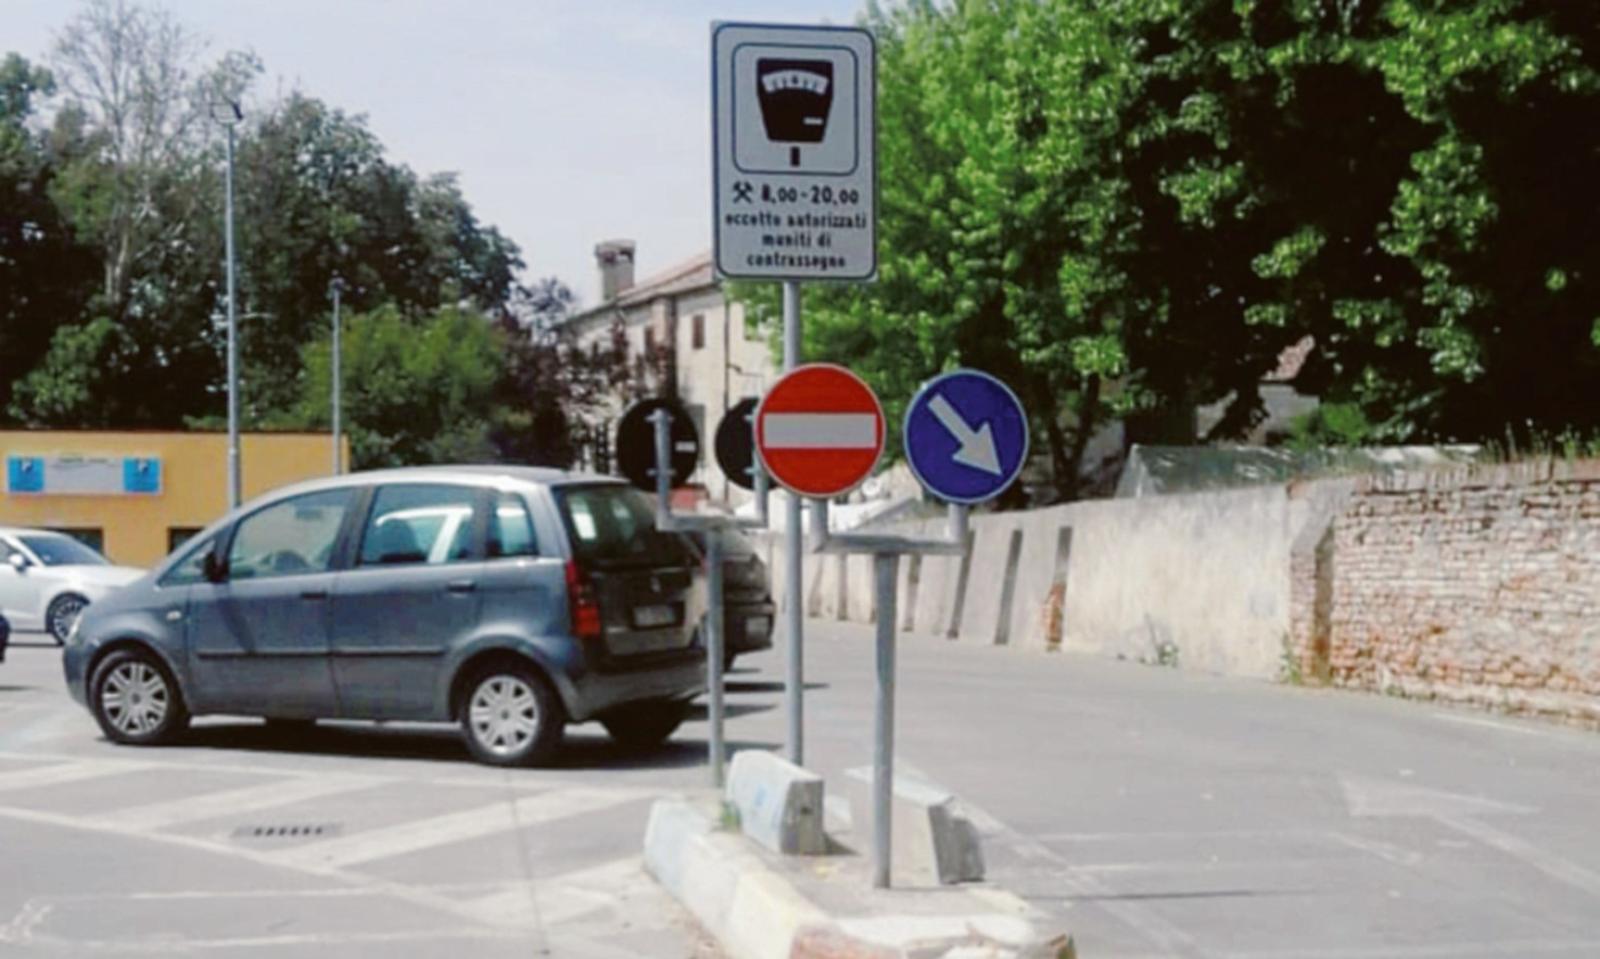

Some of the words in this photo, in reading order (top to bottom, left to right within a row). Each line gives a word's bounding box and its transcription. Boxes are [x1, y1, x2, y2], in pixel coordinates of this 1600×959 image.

[725, 212, 781, 226] eccetto
[787, 212, 868, 228] autorizzati
[762, 231, 812, 247] muniti
[817, 232, 832, 247] di
[746, 252, 846, 270] contrassegno
